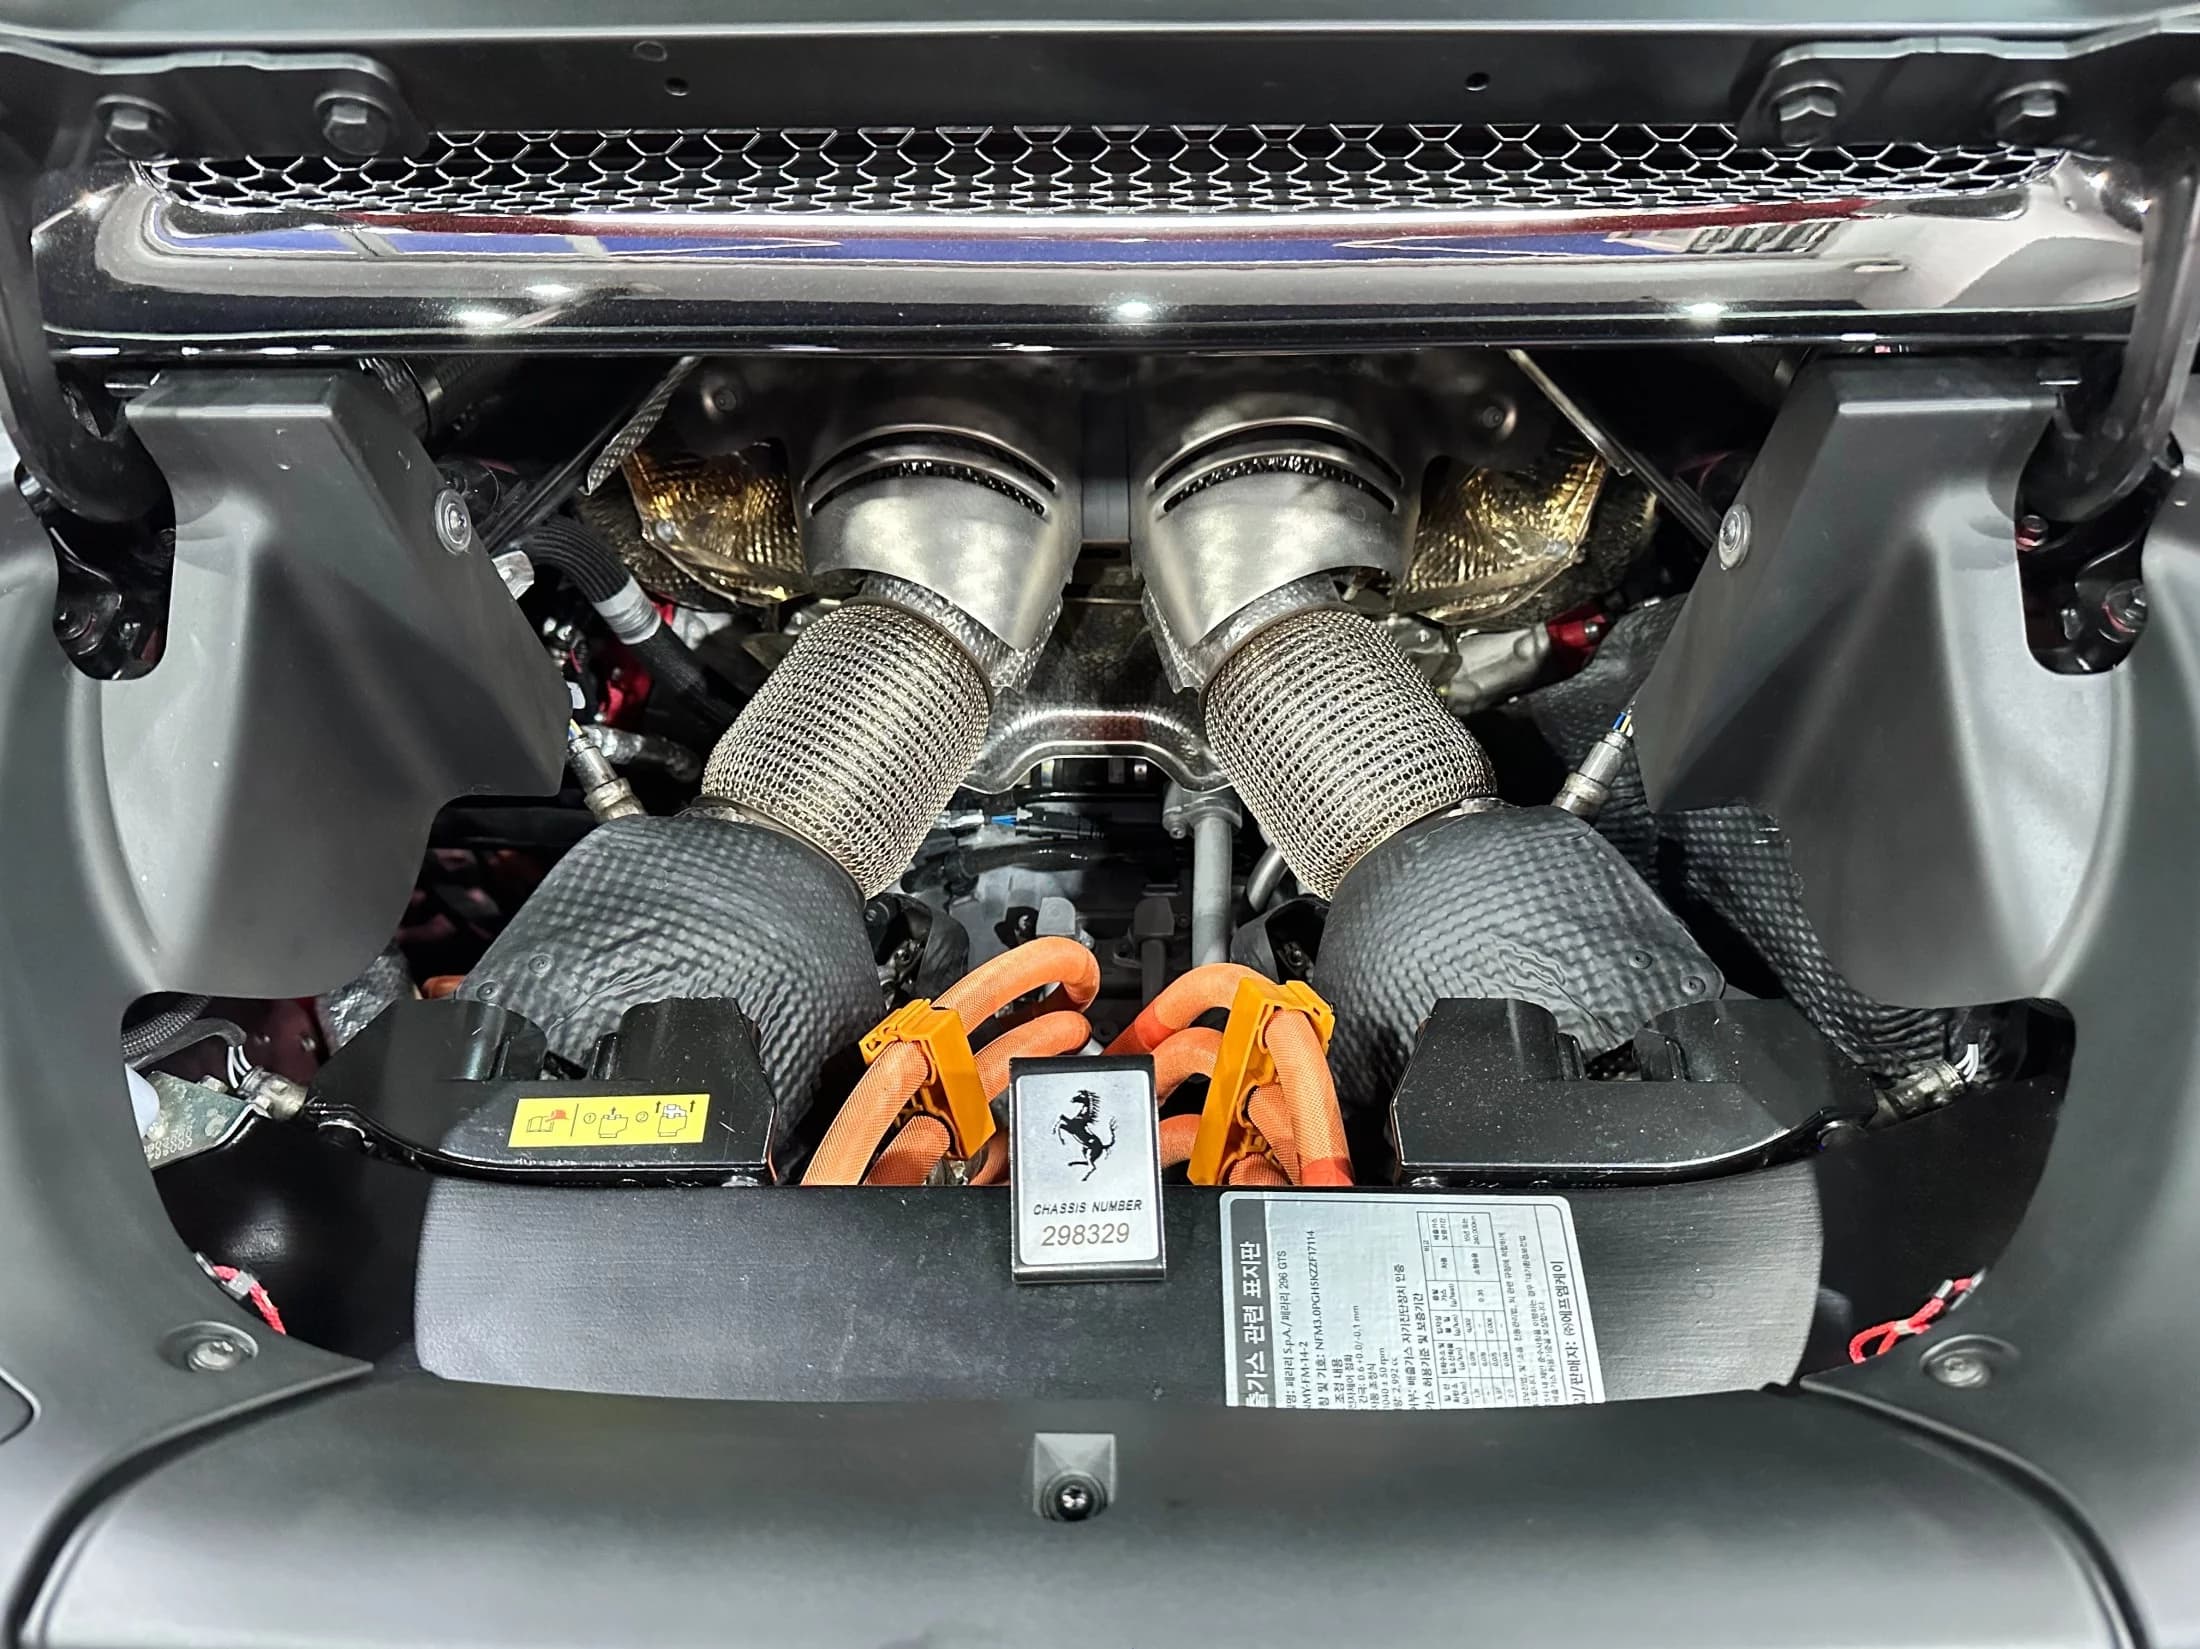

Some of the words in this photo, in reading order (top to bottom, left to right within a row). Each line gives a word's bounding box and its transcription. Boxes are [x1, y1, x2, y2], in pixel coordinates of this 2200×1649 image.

[1033, 1202, 1087, 1216] CHASSIS
[1092, 1199, 1142, 1213] NUMBER
[1041, 1222, 1130, 1247] 298329
[1240, 1241, 1262, 1298] 표지판
[1277, 1250, 1287, 1270] GTS
[1278, 1272, 1289, 1289] 296
[1242, 1305, 1265, 1344] 관련
[1283, 1357, 1295, 1386] 페라리
